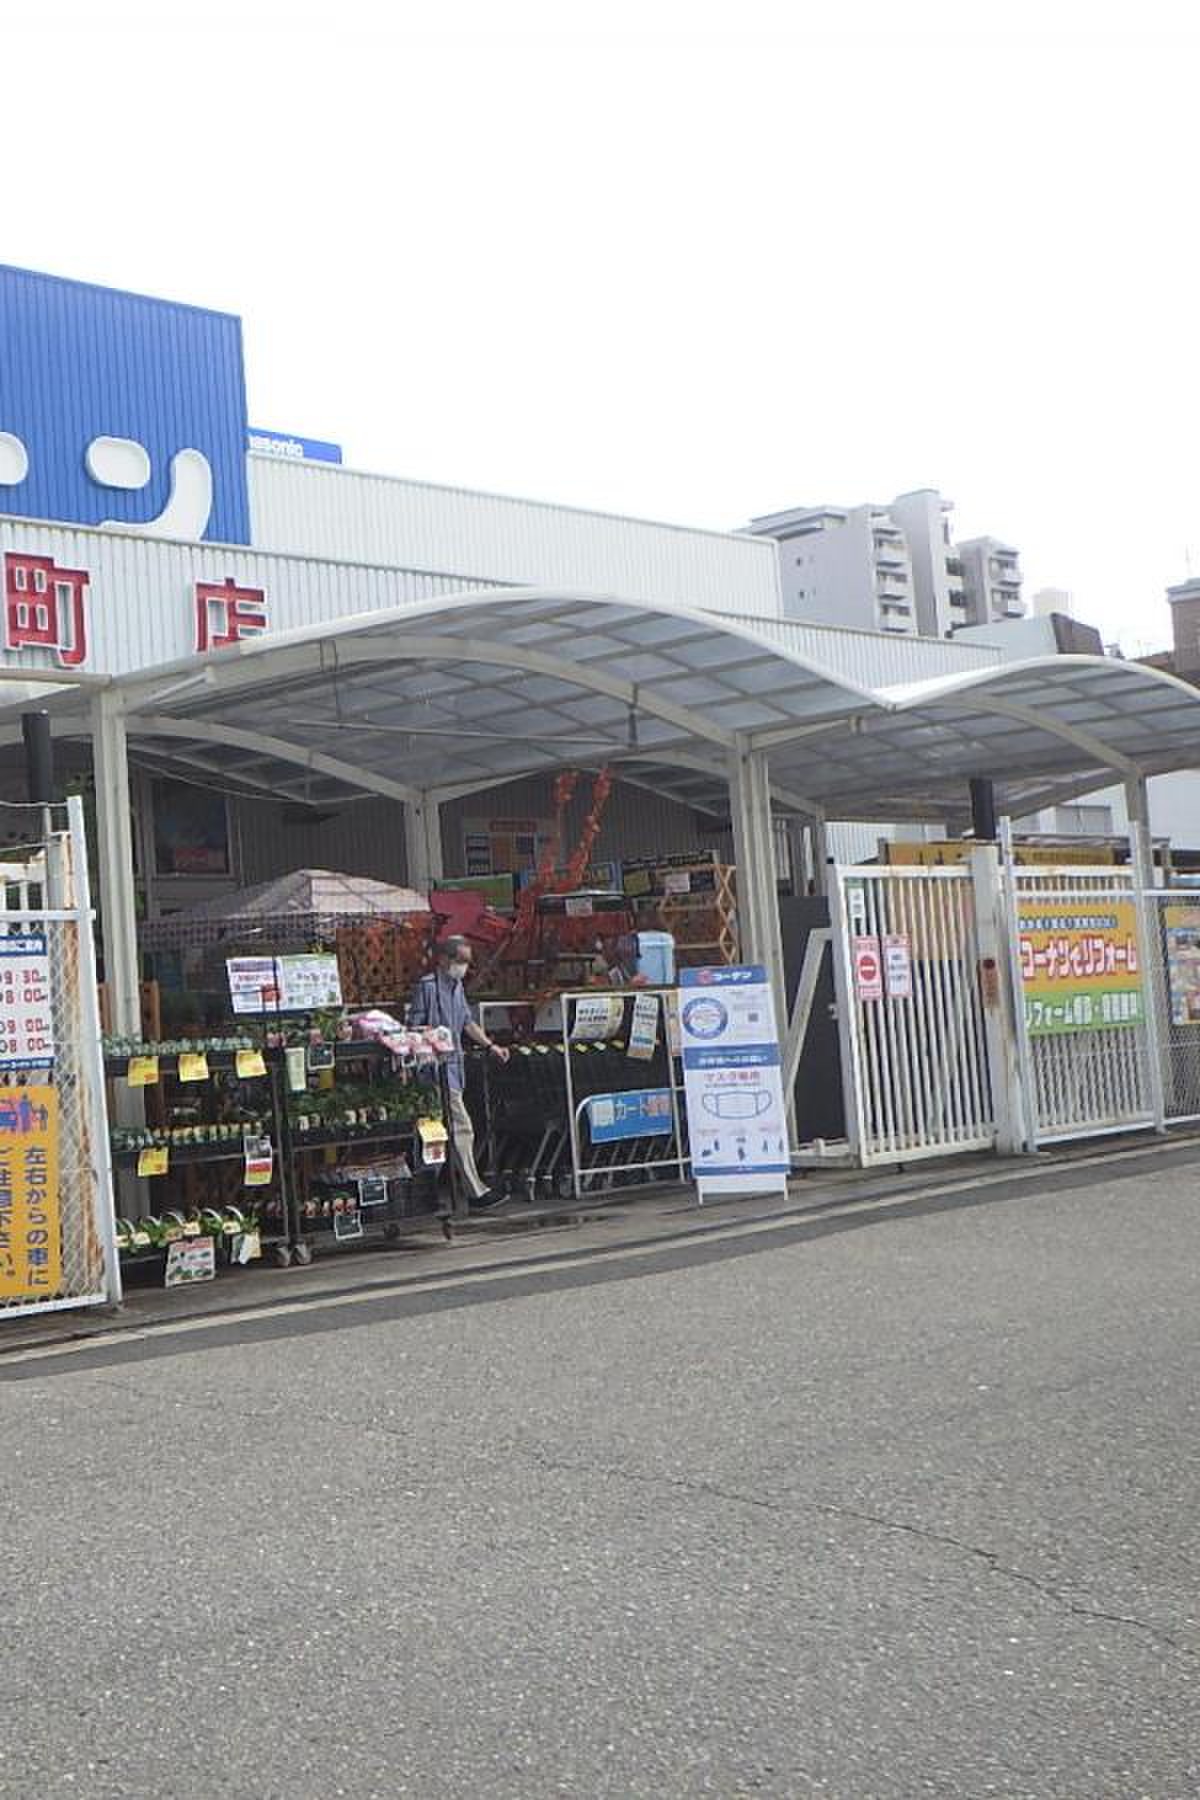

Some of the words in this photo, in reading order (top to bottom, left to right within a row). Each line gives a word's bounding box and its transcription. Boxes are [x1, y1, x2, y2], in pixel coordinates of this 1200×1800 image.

[24, 1146, 49, 1286] 左右からの車に
